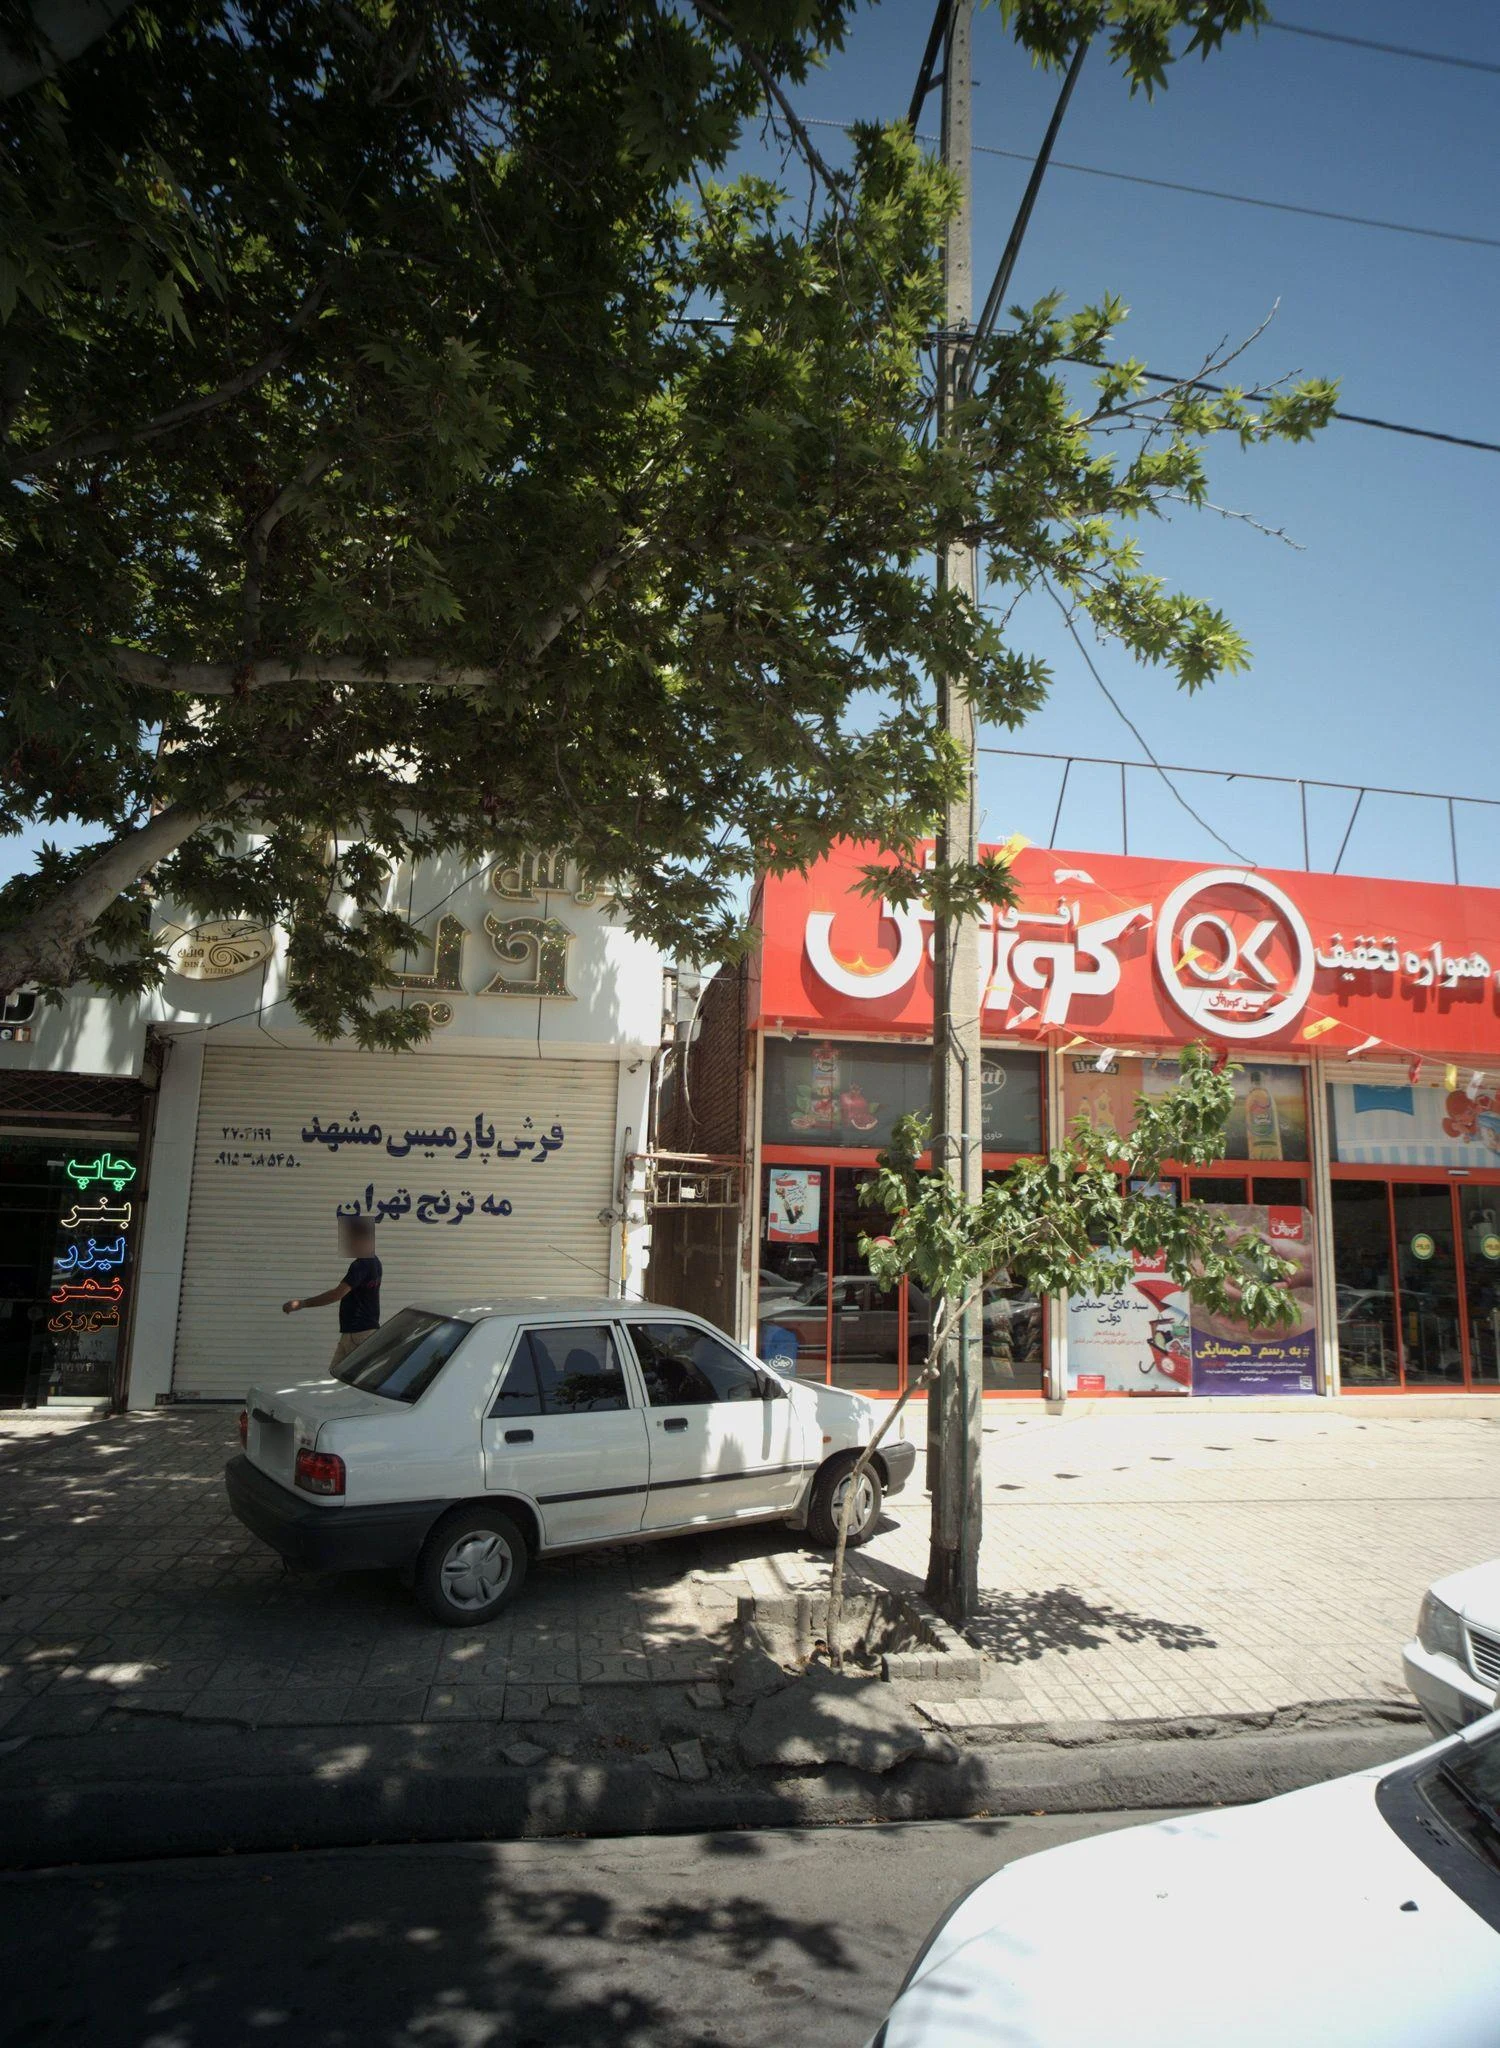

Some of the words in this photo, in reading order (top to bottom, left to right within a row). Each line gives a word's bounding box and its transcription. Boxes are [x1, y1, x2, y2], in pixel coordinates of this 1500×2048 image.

[1183, 912, 1279, 984] OK
[1313, 933, 1399, 981] تخفیف
[1405, 941, 1491, 987] همواره
[1208, 990, 1242, 1008] کوروش
[301, 1110, 382, 1152] مشهد
[386, 1112, 496, 1164] پارمیس
[496, 1113, 565, 1162] فرش
[983, 1131, 1003, 1141] حاوی
[67, 1153, 137, 1191] چاپ
[61, 1197, 132, 1230] بنر
[336, 1183, 411, 1224] تهران
[416, 1189, 475, 1225] ترنج
[480, 1193, 513, 1216] مه
[1271, 1220, 1301, 1237] کوروش
[57, 1237, 126, 1270] لیزر
[48, 1306, 120, 1332] فوری
[1071, 1299, 1105, 1312] حمایتی
[1097, 1312, 1121, 1326] دولت
[1107, 1299, 1131, 1312] کالای
[1132, 1302, 1149, 1312] سبد
